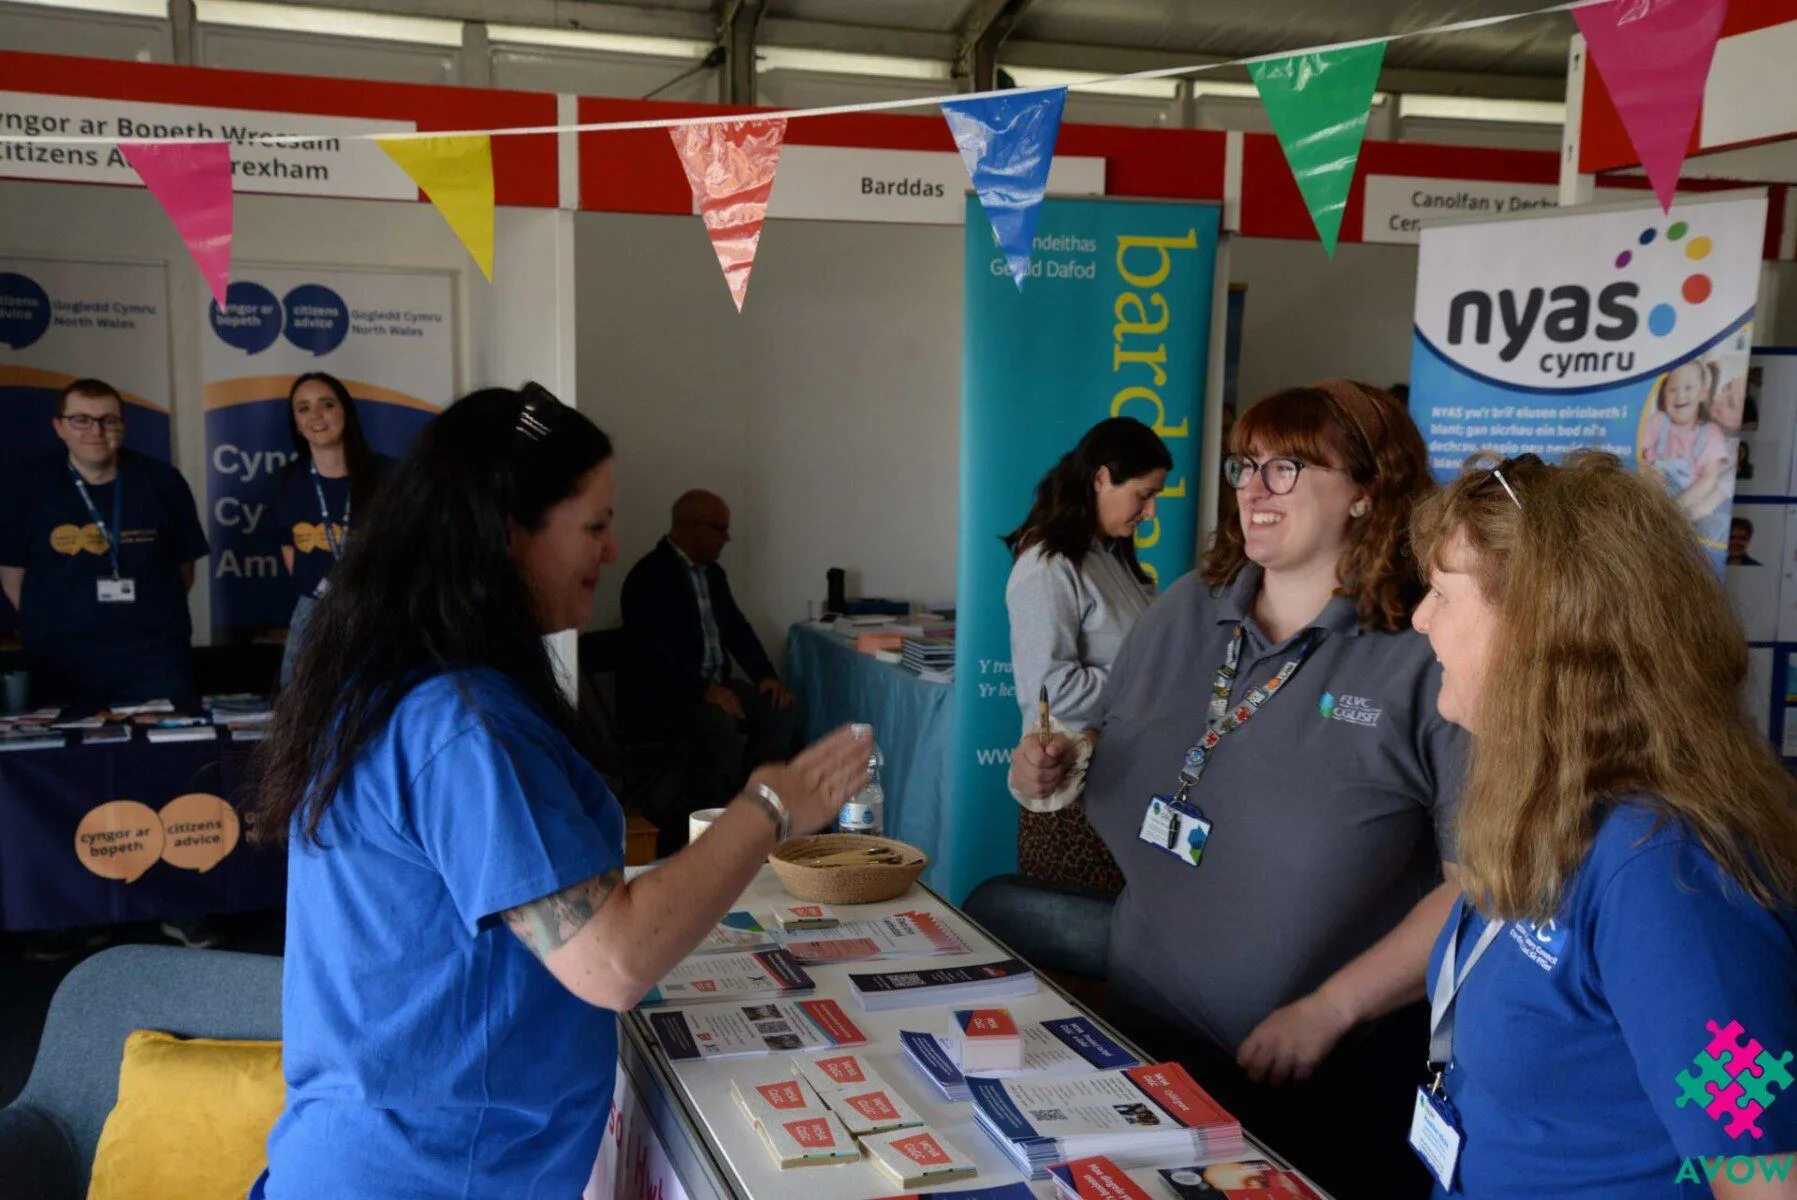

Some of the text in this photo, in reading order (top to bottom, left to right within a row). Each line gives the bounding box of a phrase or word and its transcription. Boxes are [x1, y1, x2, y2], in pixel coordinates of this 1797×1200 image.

[79, 117, 108, 137] ar
[0, 141, 98, 166] itizens
[230, 159, 329, 180] rexham
[861, 177, 944, 197] Barddas
[1411, 190, 1489, 211] Canolfan
[1047, 260, 1096, 279] Dafod
[53, 300, 109, 313] Gogledd
[293, 304, 339, 317] citizens
[54, 316, 93, 327] North
[294, 317, 334, 329] advice
[352, 309, 442, 324] Gogledd Cymru
[1447, 281, 1640, 362] nyas
[352, 325, 423, 338] North Wales
[1540, 350, 1635, 378] cymru
[167, 819, 222, 835] citizens
[80, 826, 150, 846] cyngor ar
[174, 834, 220, 848] advice
[90, 841, 143, 857] bopeth
